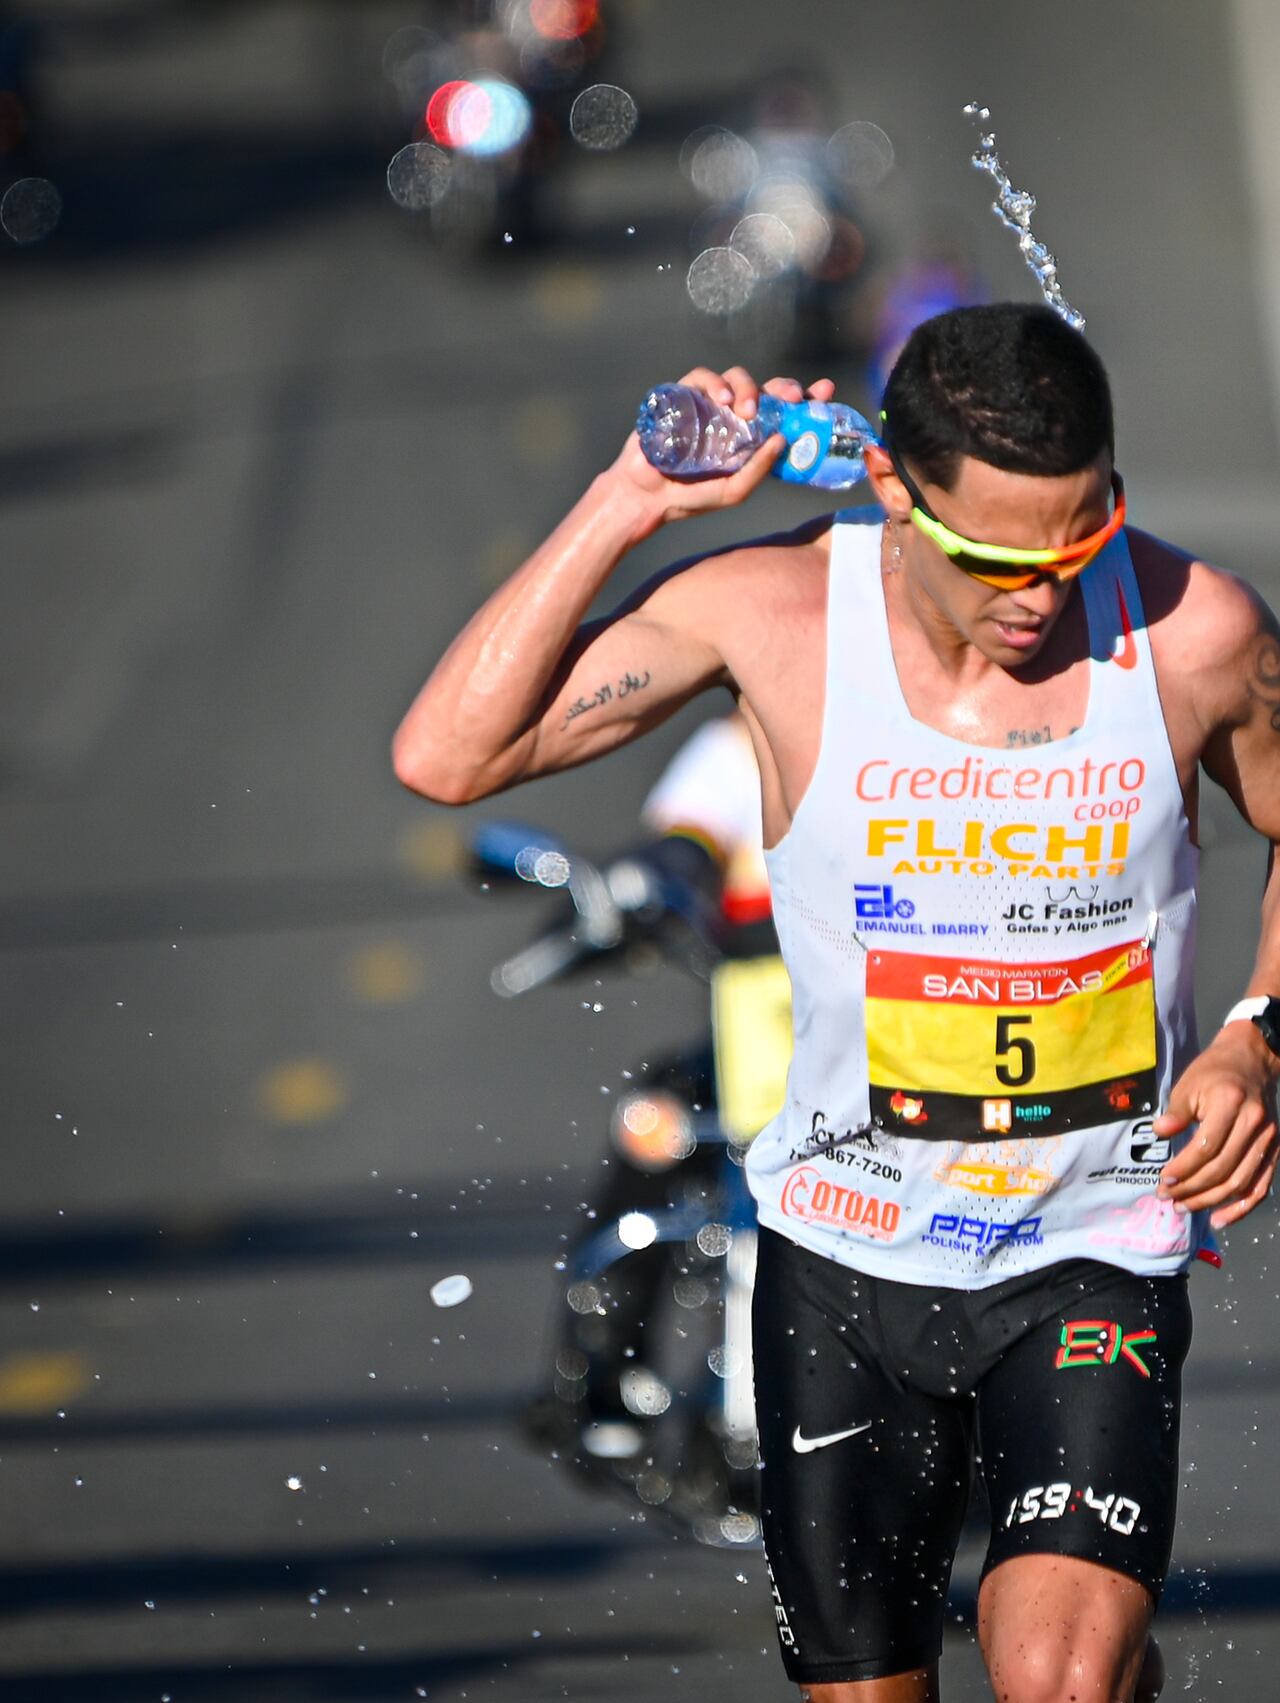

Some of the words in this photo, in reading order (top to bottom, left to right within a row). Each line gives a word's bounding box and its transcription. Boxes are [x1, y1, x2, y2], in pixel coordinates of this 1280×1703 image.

[855, 757, 1146, 802] Credicentro
[1074, 797, 1140, 822] coop
[866, 819, 1130, 863] FLICHI
[892, 860, 994, 876] AUTO
[1008, 862, 1126, 879] PARTS
[1002, 904, 1034, 920] JC
[1044, 897, 1133, 920] Fashion
[856, 920, 926, 935] EMANUEL
[932, 924, 989, 935] IBARRY
[1007, 923, 1049, 934] Gafas
[1054, 925, 1062, 935] y
[1066, 921, 1098, 933] Algo
[961, 965, 1000, 977] MEDIO
[924, 974, 1000, 1001] SAN
[1011, 970, 1104, 1001] BLAS
[995, 1014, 1036, 1087] 5
[985, 1102, 1010, 1130] H
[1015, 1105, 1052, 1118] hello
[920, 1234, 972, 1253] POLISH
